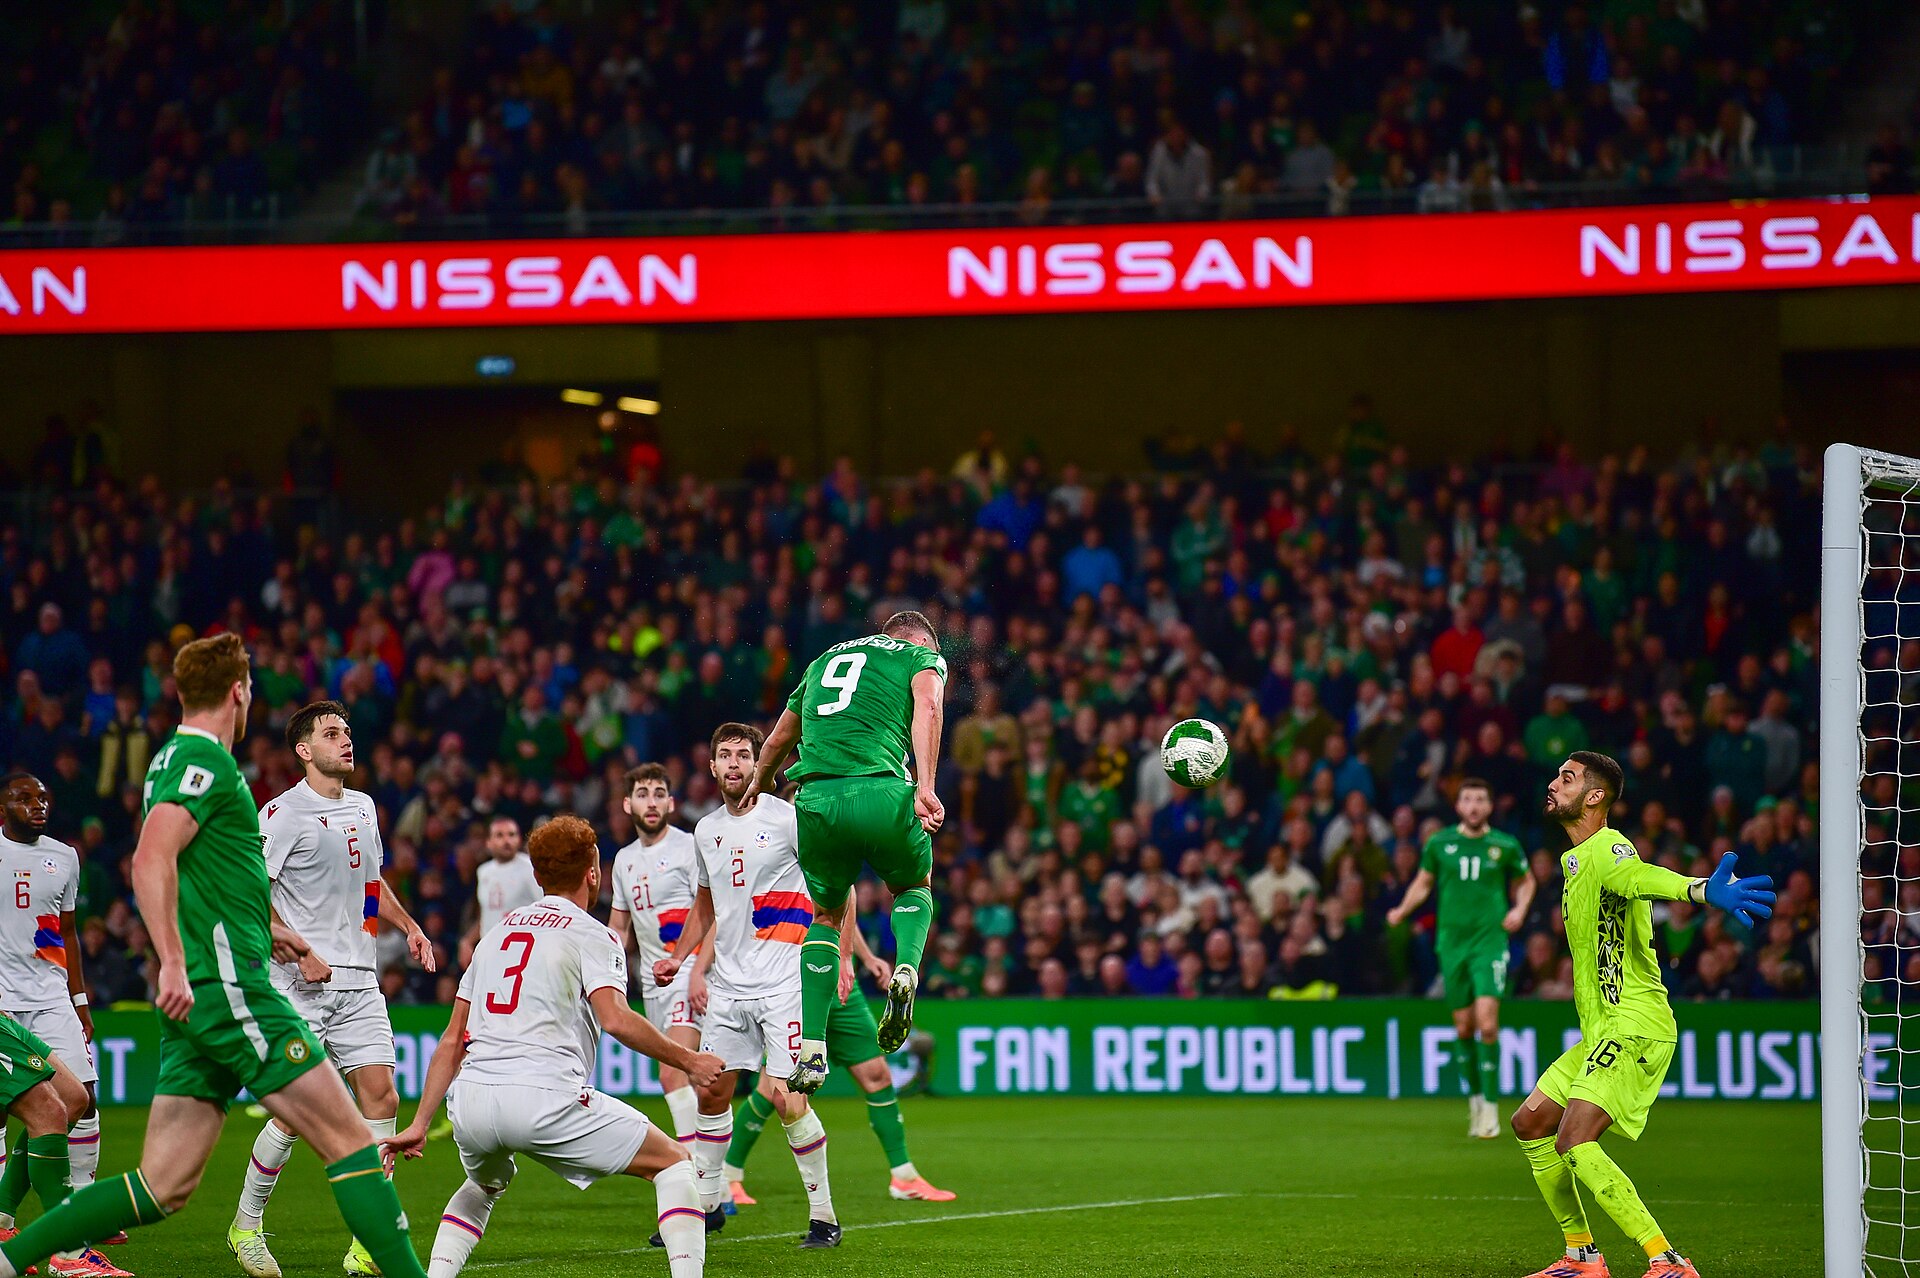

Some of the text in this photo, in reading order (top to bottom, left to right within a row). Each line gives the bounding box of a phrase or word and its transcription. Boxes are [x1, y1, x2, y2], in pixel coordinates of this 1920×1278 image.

[948, 235, 1313, 298] NISSAN
[1580, 211, 1920, 277] NISSA
[341, 253, 697, 311] NISSAN
[816, 652, 867, 716] 9
[347, 837, 361, 869] 5
[731, 858, 746, 887] 2
[1459, 855, 1481, 881] 11
[15, 881, 31, 909] 6
[631, 884, 654, 911] 21
[486, 932, 535, 1015] 3
[787, 1021, 802, 1051] 2
[1586, 1038, 1623, 1068] 16
[958, 1026, 1366, 1093] FAN REPUBLIC
[1421, 1025, 1538, 1096] FN
